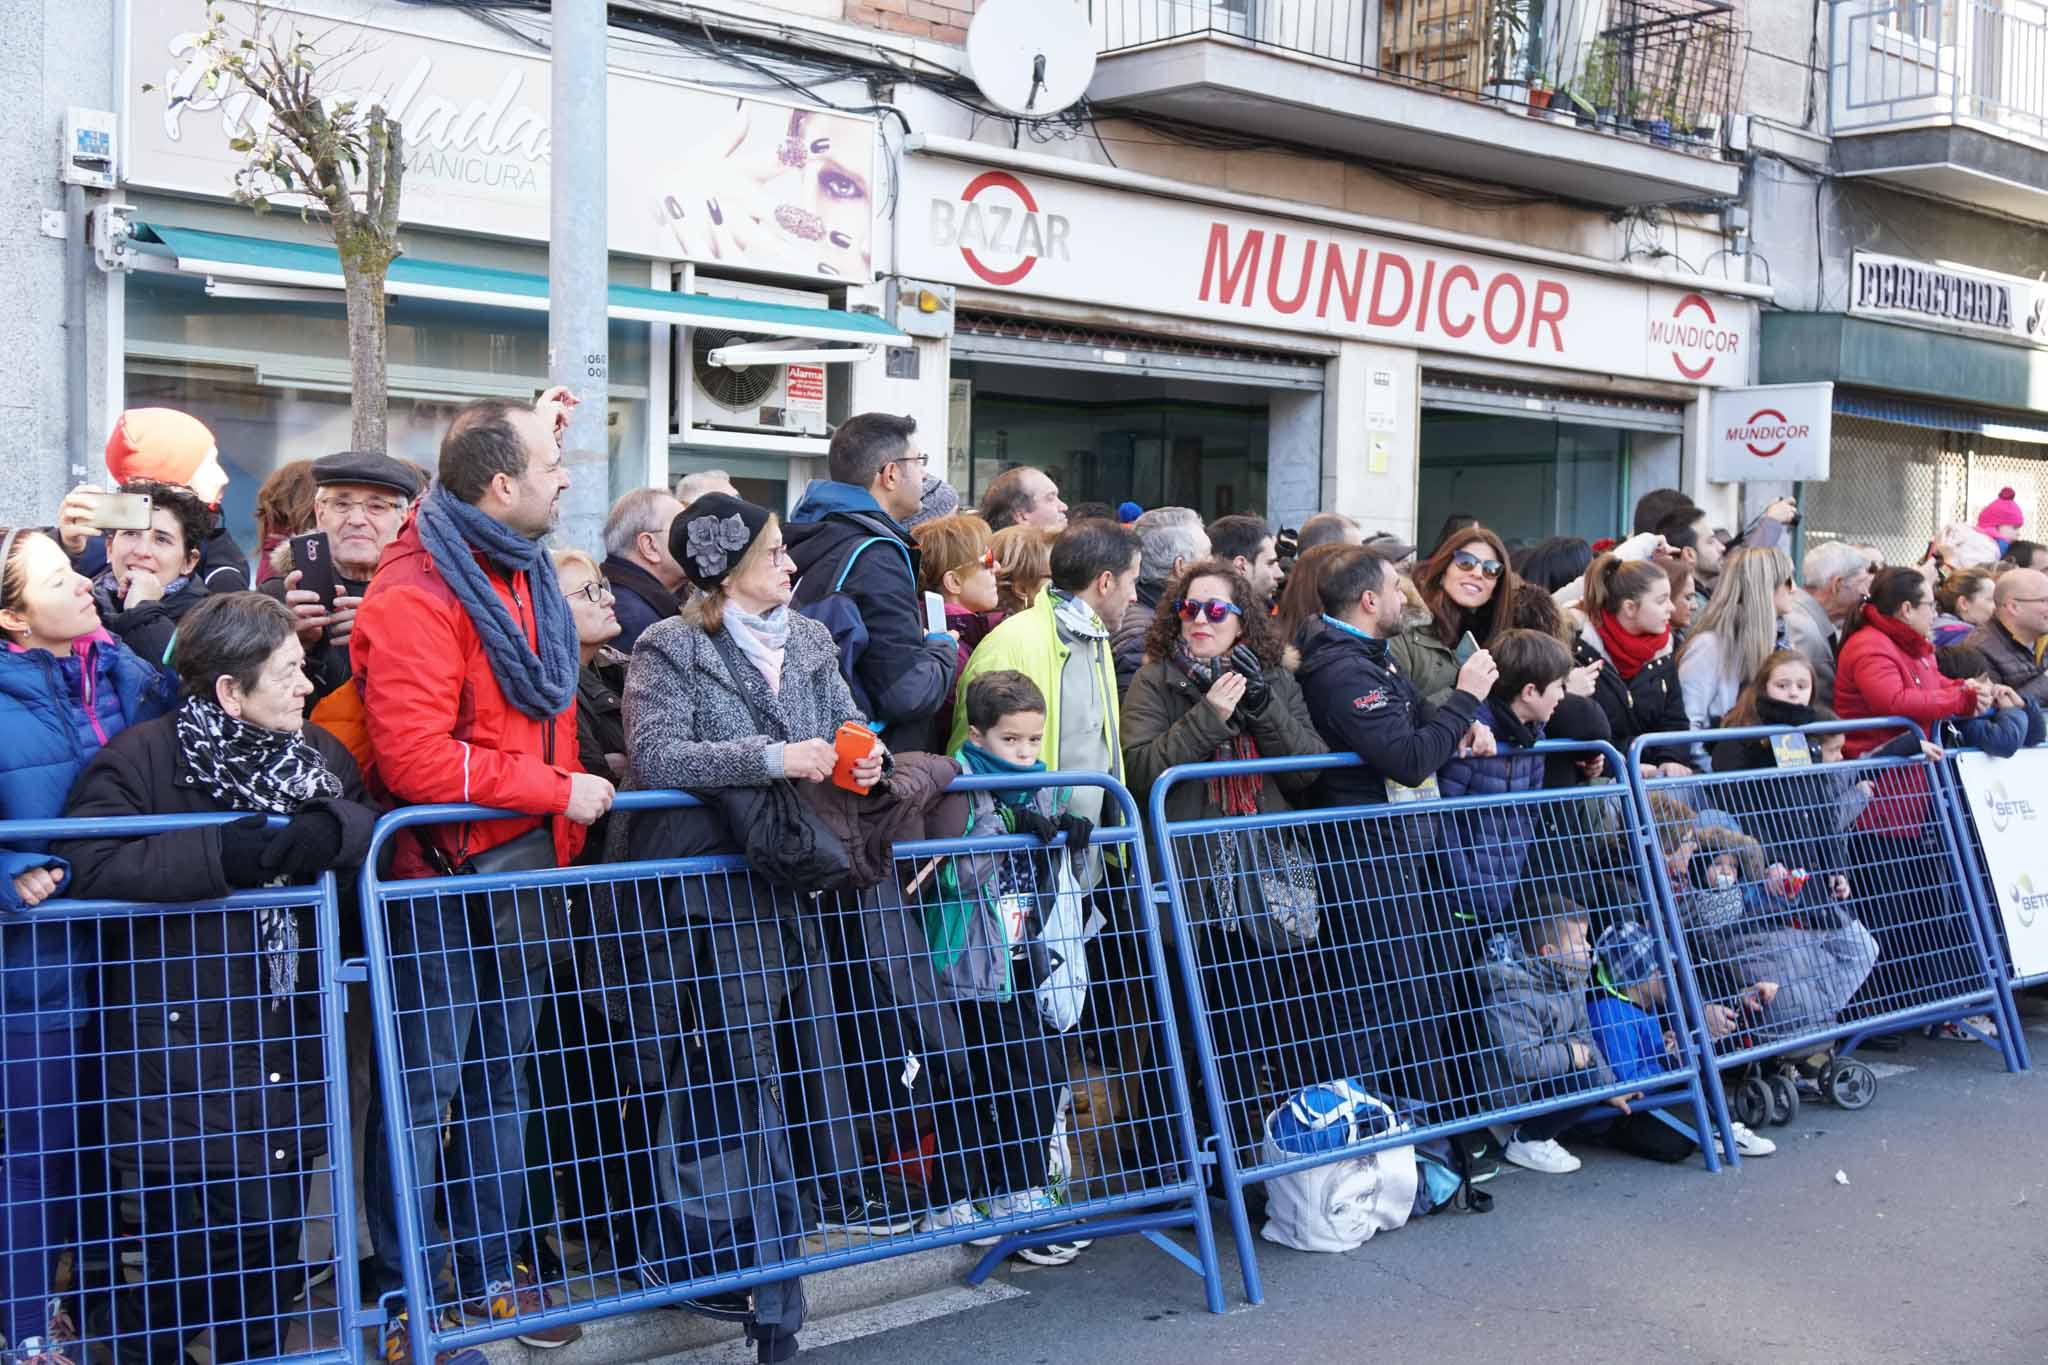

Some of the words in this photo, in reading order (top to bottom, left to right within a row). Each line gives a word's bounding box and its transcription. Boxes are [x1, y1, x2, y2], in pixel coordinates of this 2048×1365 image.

[929, 197, 1071, 262] BAZAR
[1199, 222, 1570, 353] MUNDICOR
[1650, 320, 1740, 353] MUNDICOR
[788, 366, 823, 379] Alarma
[1725, 425, 1809, 442] MUNDICOR
